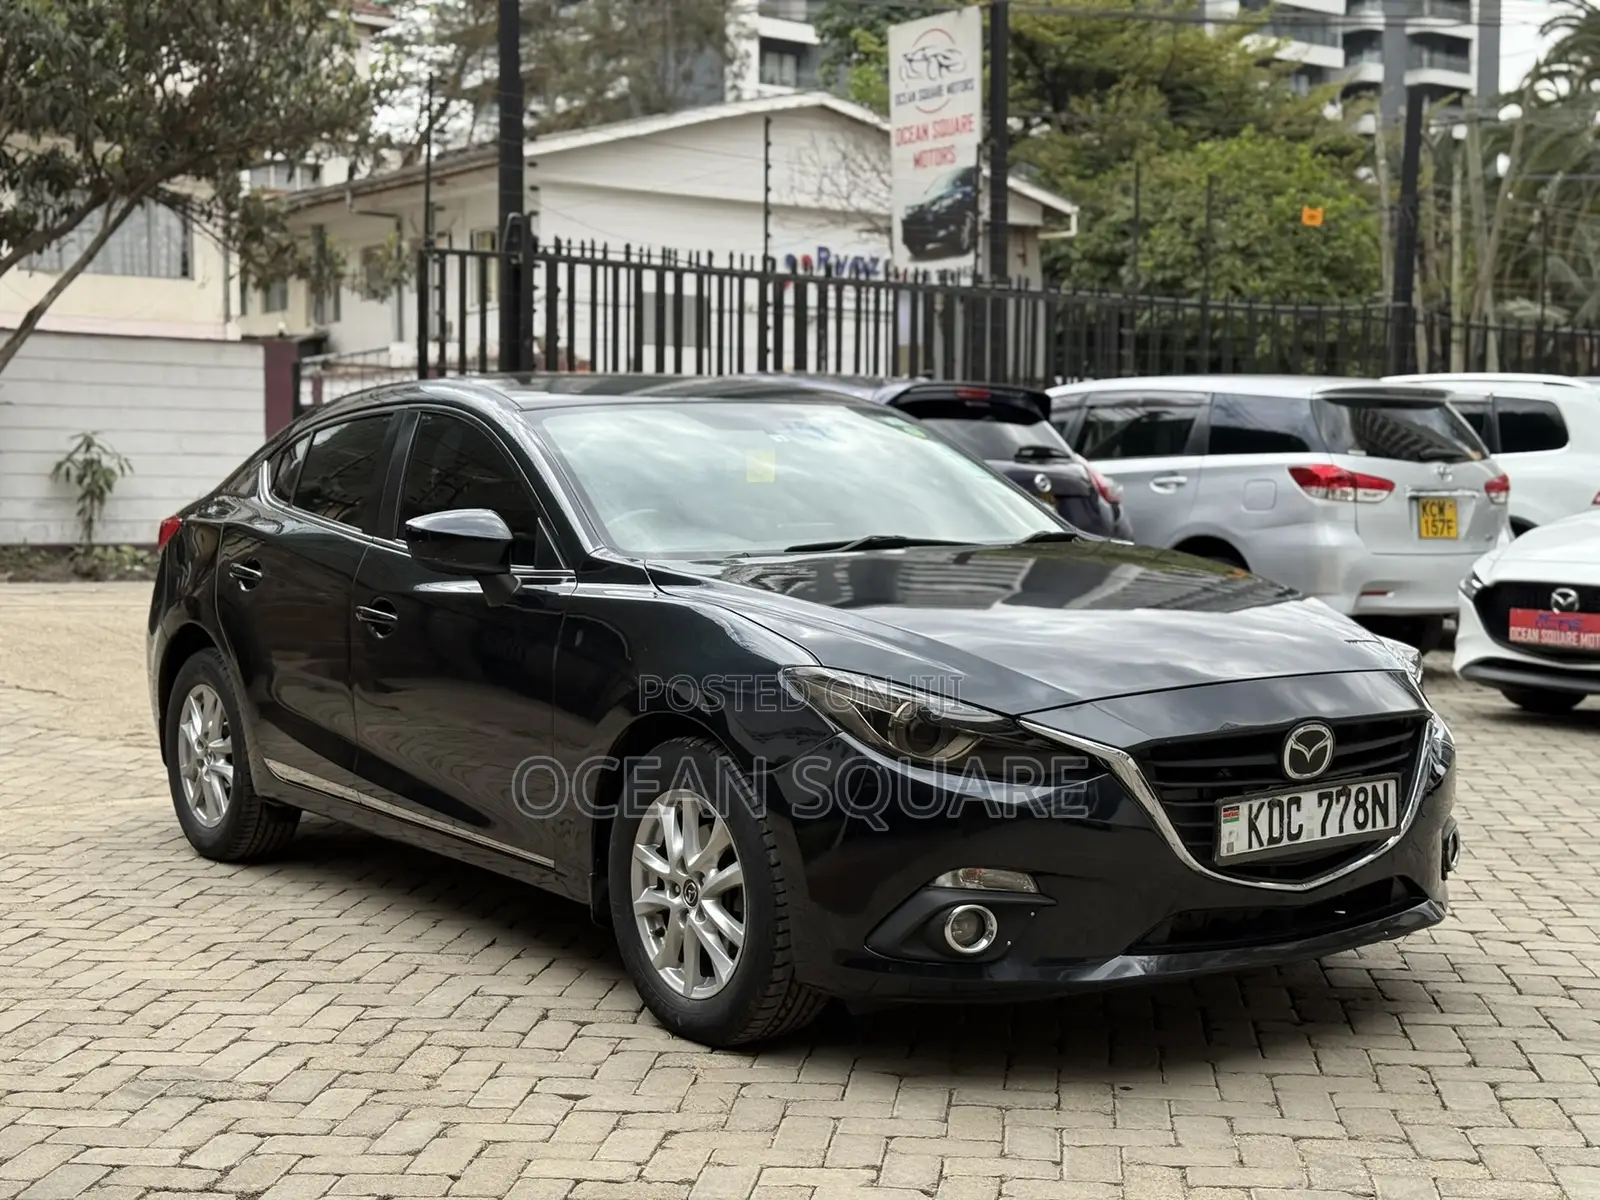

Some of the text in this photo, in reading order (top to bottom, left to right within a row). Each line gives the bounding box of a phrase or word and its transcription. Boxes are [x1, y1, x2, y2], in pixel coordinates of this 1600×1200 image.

[895, 78, 974, 106] OCEAN SQUARE MOTORS
[895, 113, 975, 146] OCEAN SQUARE
[913, 145, 956, 170] MOTORS
[1424, 518, 1454, 537] 157F
[1509, 627, 1539, 643] OCEAN
[1541, 630, 1578, 647] SQUARE
[1248, 782, 1390, 850] KDC 778N
